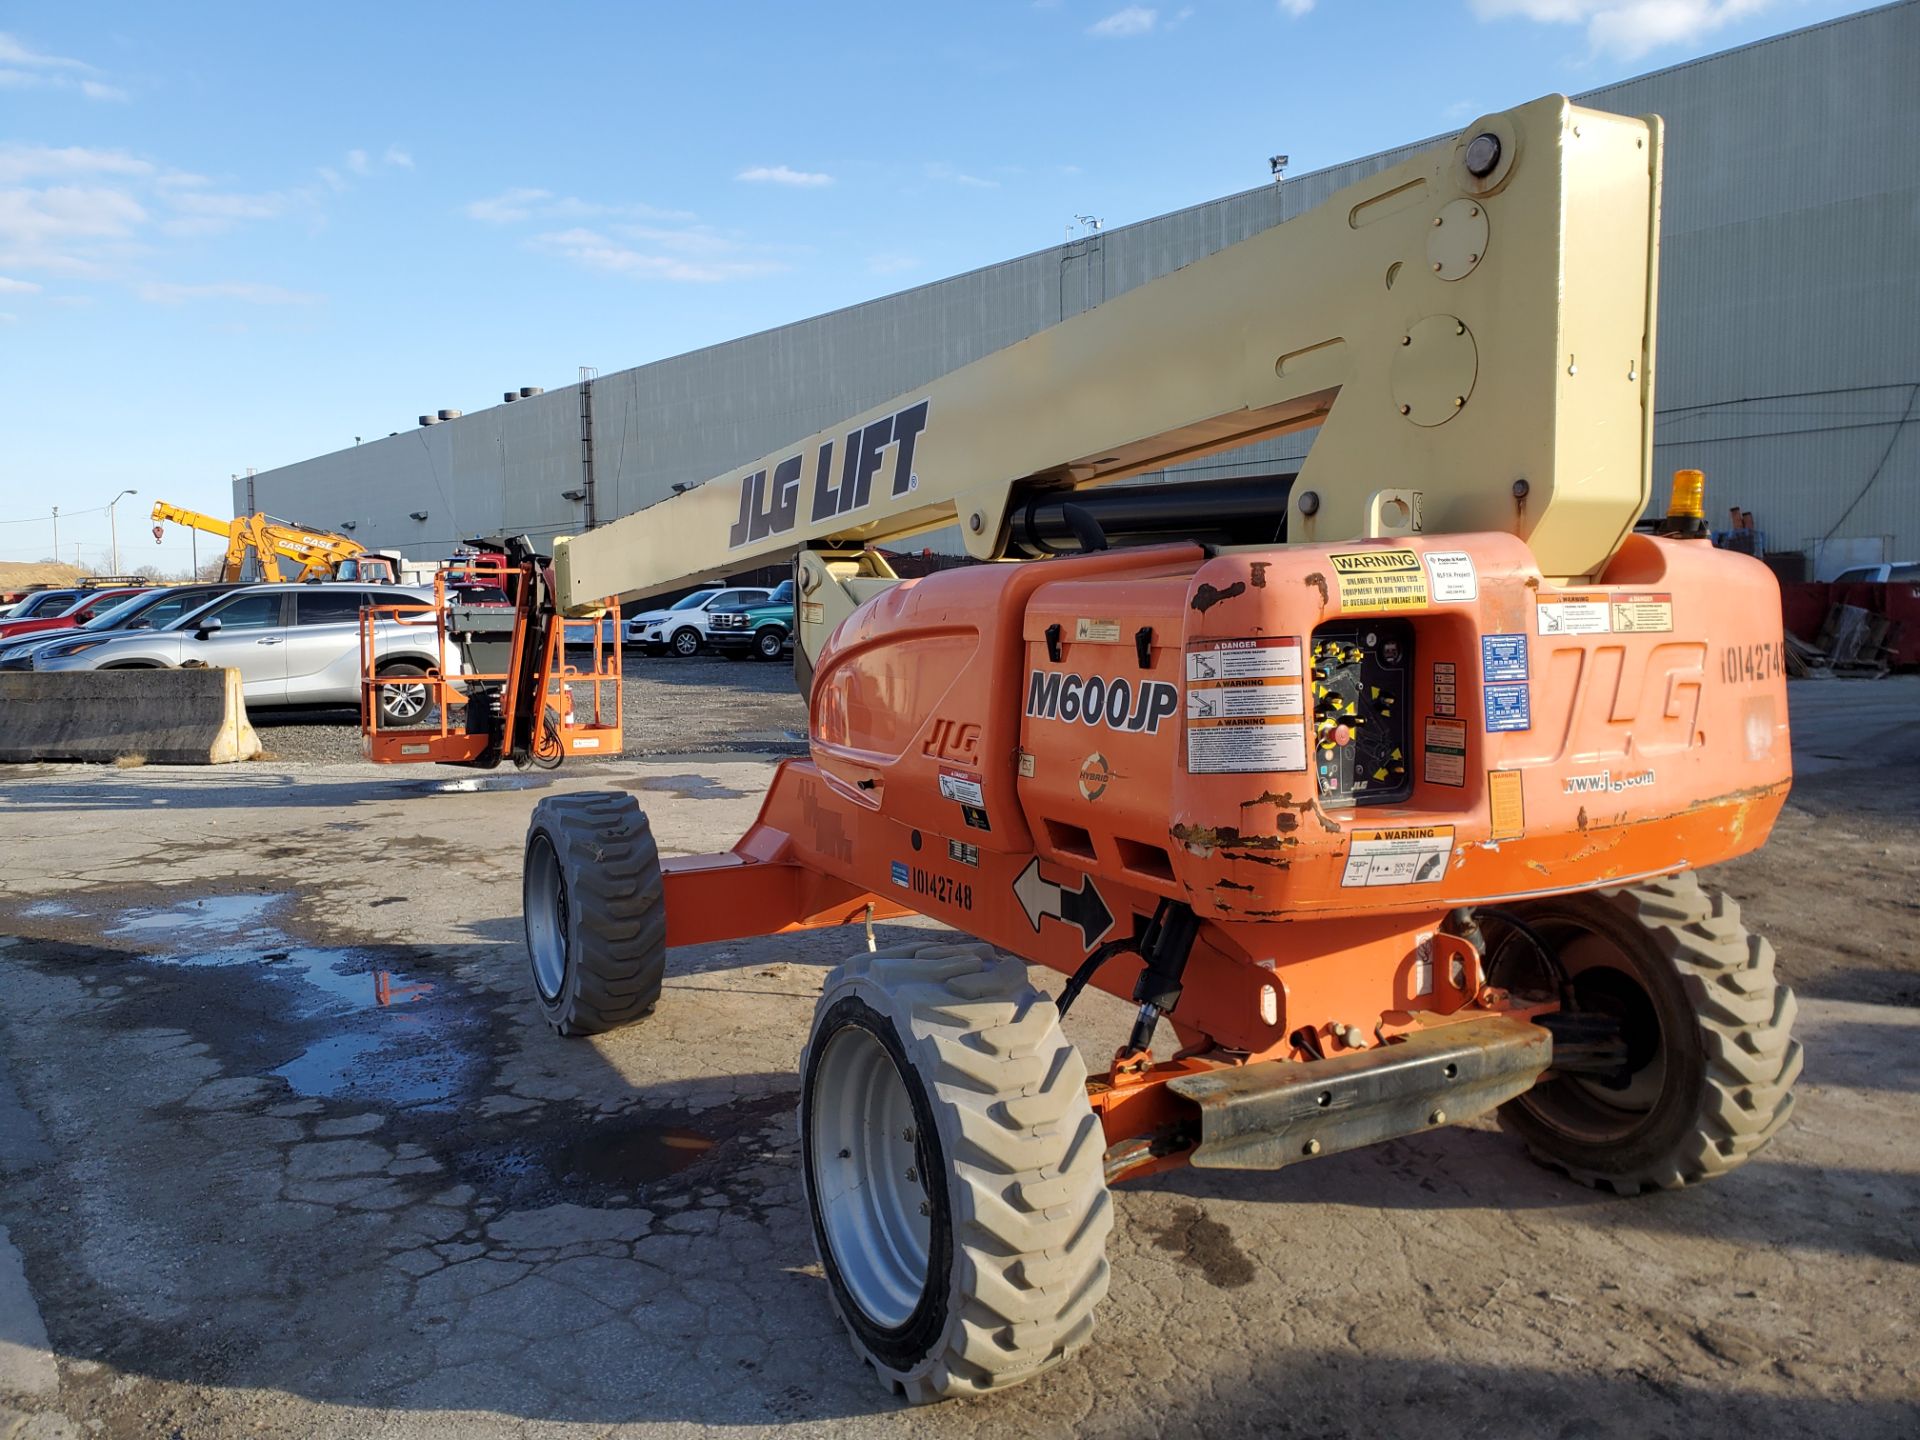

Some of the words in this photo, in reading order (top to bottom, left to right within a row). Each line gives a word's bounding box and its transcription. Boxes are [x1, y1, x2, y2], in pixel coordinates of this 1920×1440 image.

[730, 453, 803, 548] JLG
[811, 398, 930, 524] LIFT
[278, 540, 308, 552] CASE
[302, 536, 333, 550] CASE
[1335, 554, 1416, 569] WARNING
[1346, 576, 1375, 586] UNLAWFUL
[1375, 576, 1382, 584] TO
[1383, 575, 1405, 585] OPERATE
[1406, 575, 1418, 583] THIS
[1342, 587, 1373, 597] EQUIPMENT
[1374, 586, 1394, 596] WITHIN
[1395, 585, 1413, 594] TWENTY
[1413, 584, 1424, 593] FEET
[1342, 599, 1349, 607] OF
[1350, 598, 1376, 607] OVERHEAD
[1377, 597, 1390, 605] HIGH
[1391, 596, 1412, 604] VOLTAGE
[1412, 595, 1426, 603] LINES
[1221, 641, 1257, 649] DANGER
[1223, 679, 1264, 687] WARNING
[1027, 670, 1178, 735] M600JP
[1498, 641, 1708, 769] JLG
[1224, 718, 1266, 726] WARNING
[922, 718, 981, 765] JLG
[1080, 770, 1109, 783] HYBRID
[1384, 829, 1435, 840] WARNING
[912, 866, 972, 911] 10142748
